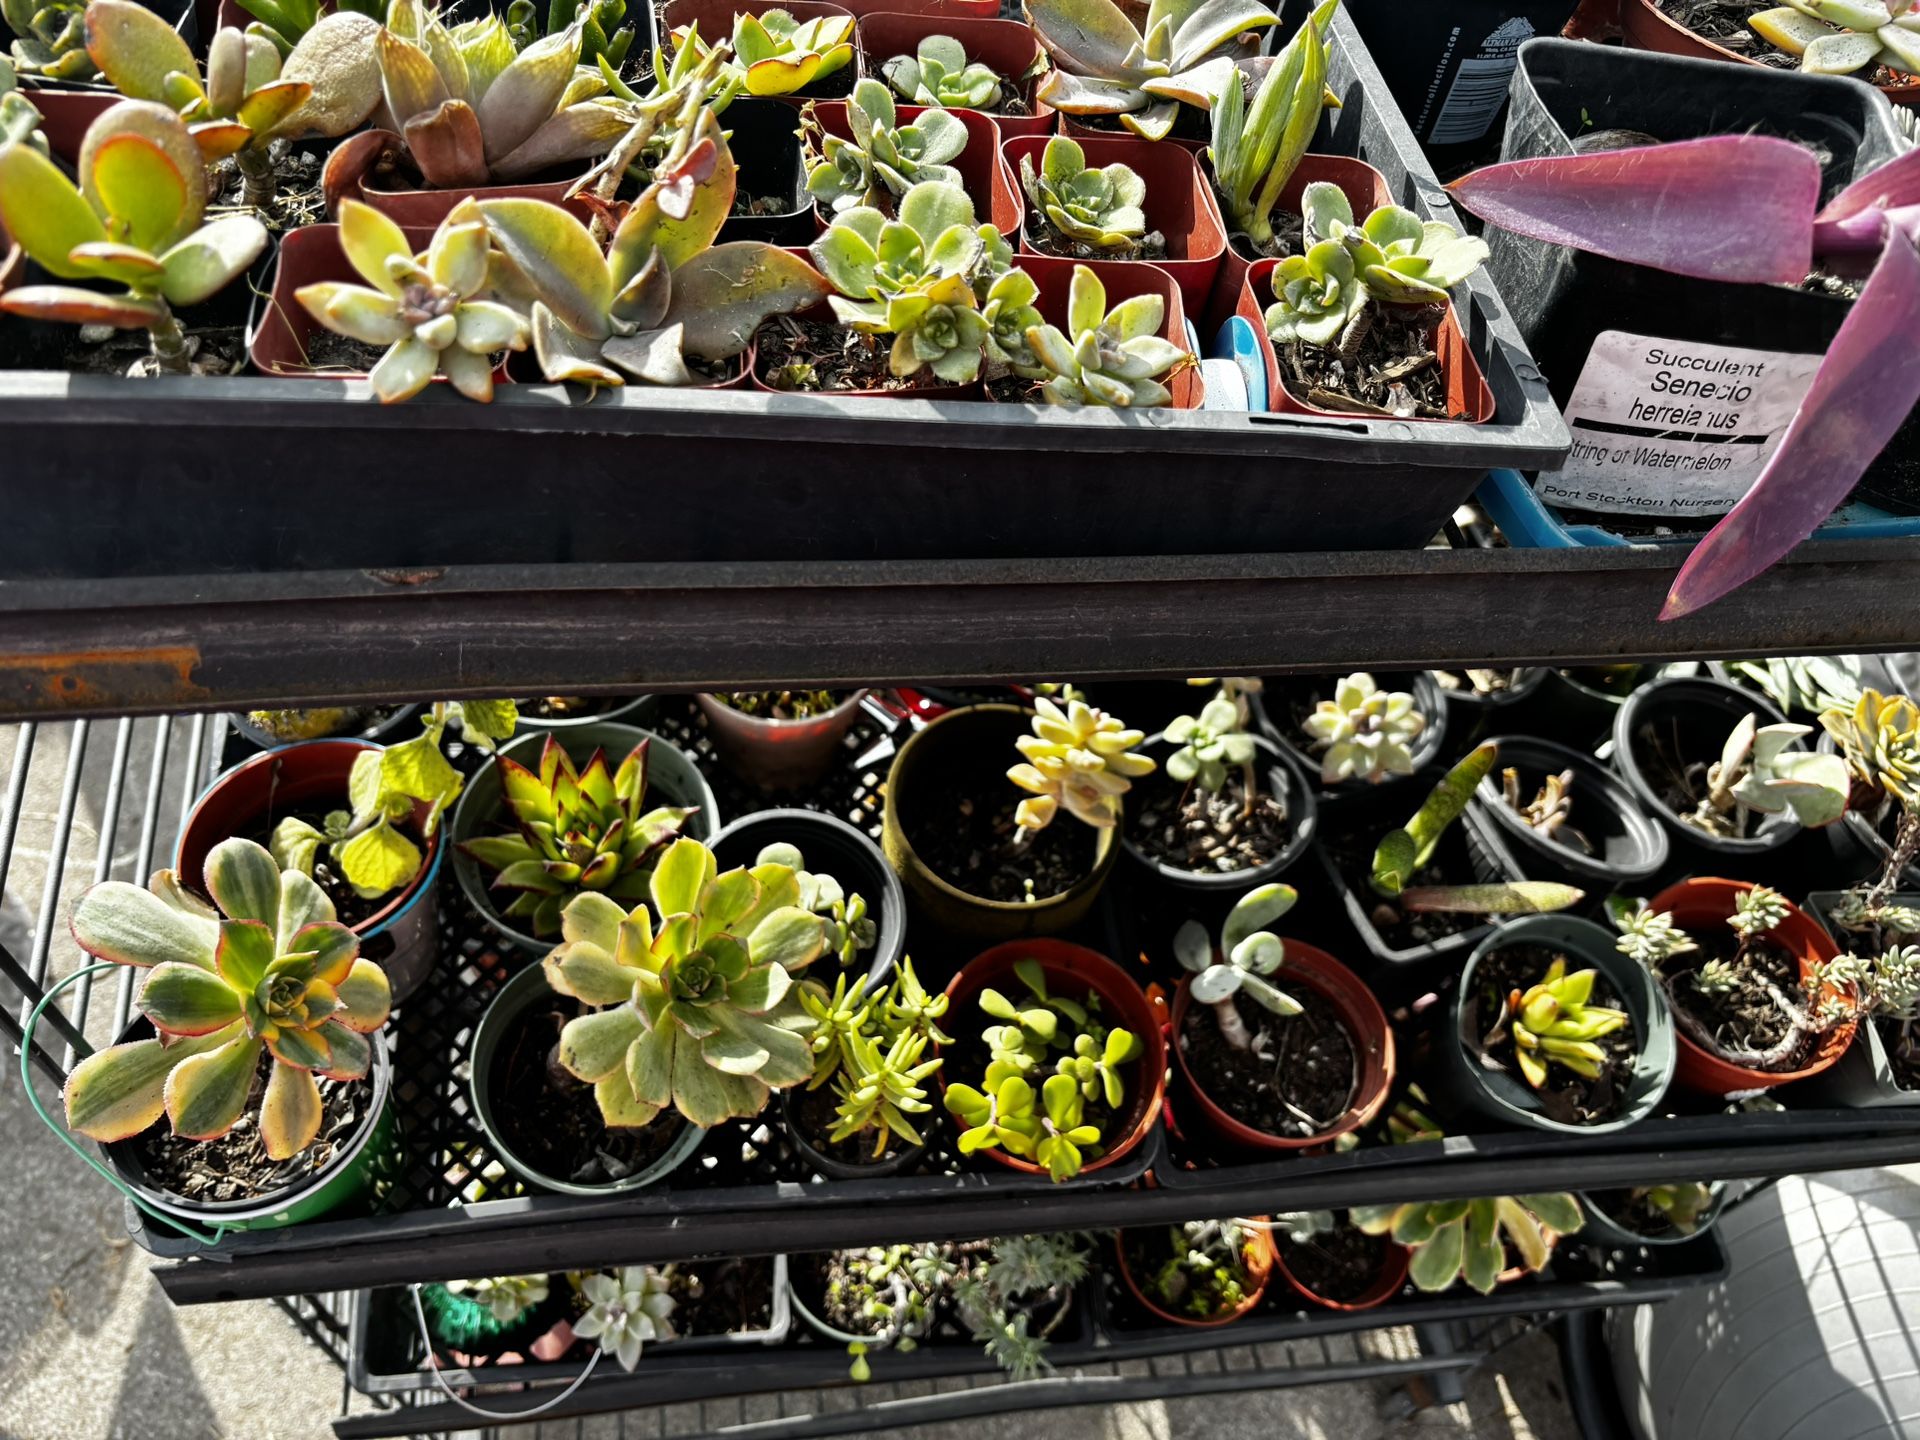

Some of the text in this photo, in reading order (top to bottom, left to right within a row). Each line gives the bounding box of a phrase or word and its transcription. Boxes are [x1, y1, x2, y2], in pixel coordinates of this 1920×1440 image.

[1645, 349, 1765, 377] Succulent
[1650, 370, 1752, 402] Senecio
[1633, 447, 1732, 470] Watermelon
[1543, 485, 1581, 499] Port
